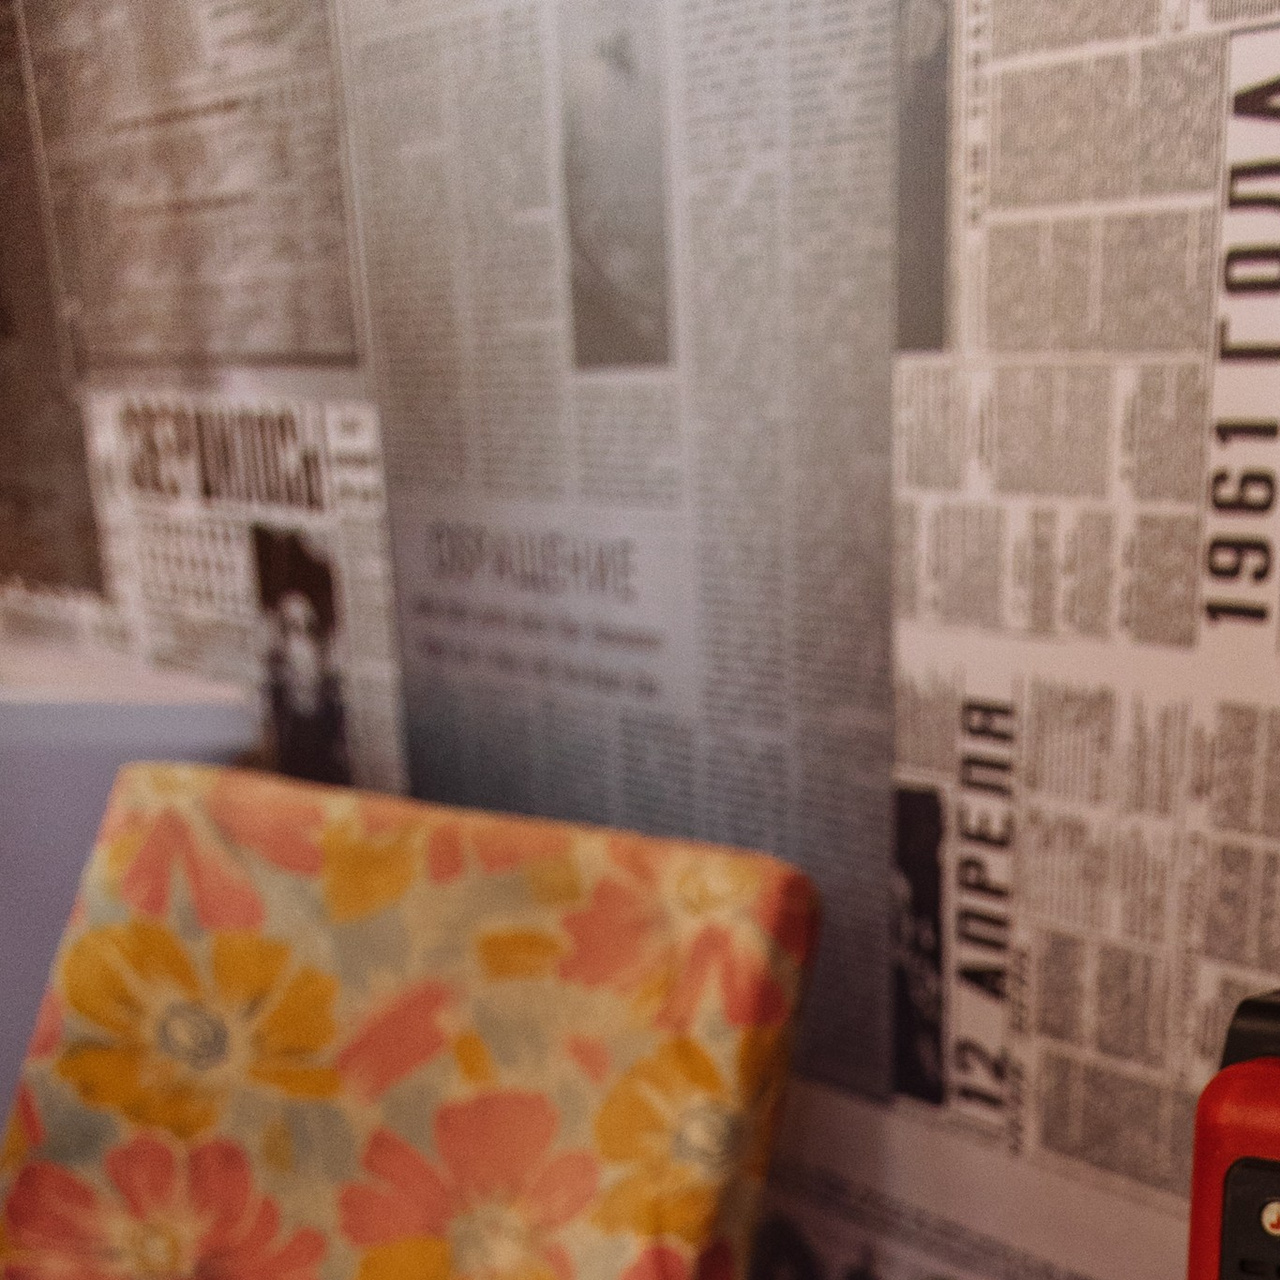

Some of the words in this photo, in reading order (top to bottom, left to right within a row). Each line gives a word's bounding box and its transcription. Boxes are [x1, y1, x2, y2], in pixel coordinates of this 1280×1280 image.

[1205, 418, 1280, 624] 1961
[955, 694, 1019, 1003] АПРЕЛЯ
[953, 1034, 1009, 1114] 12
